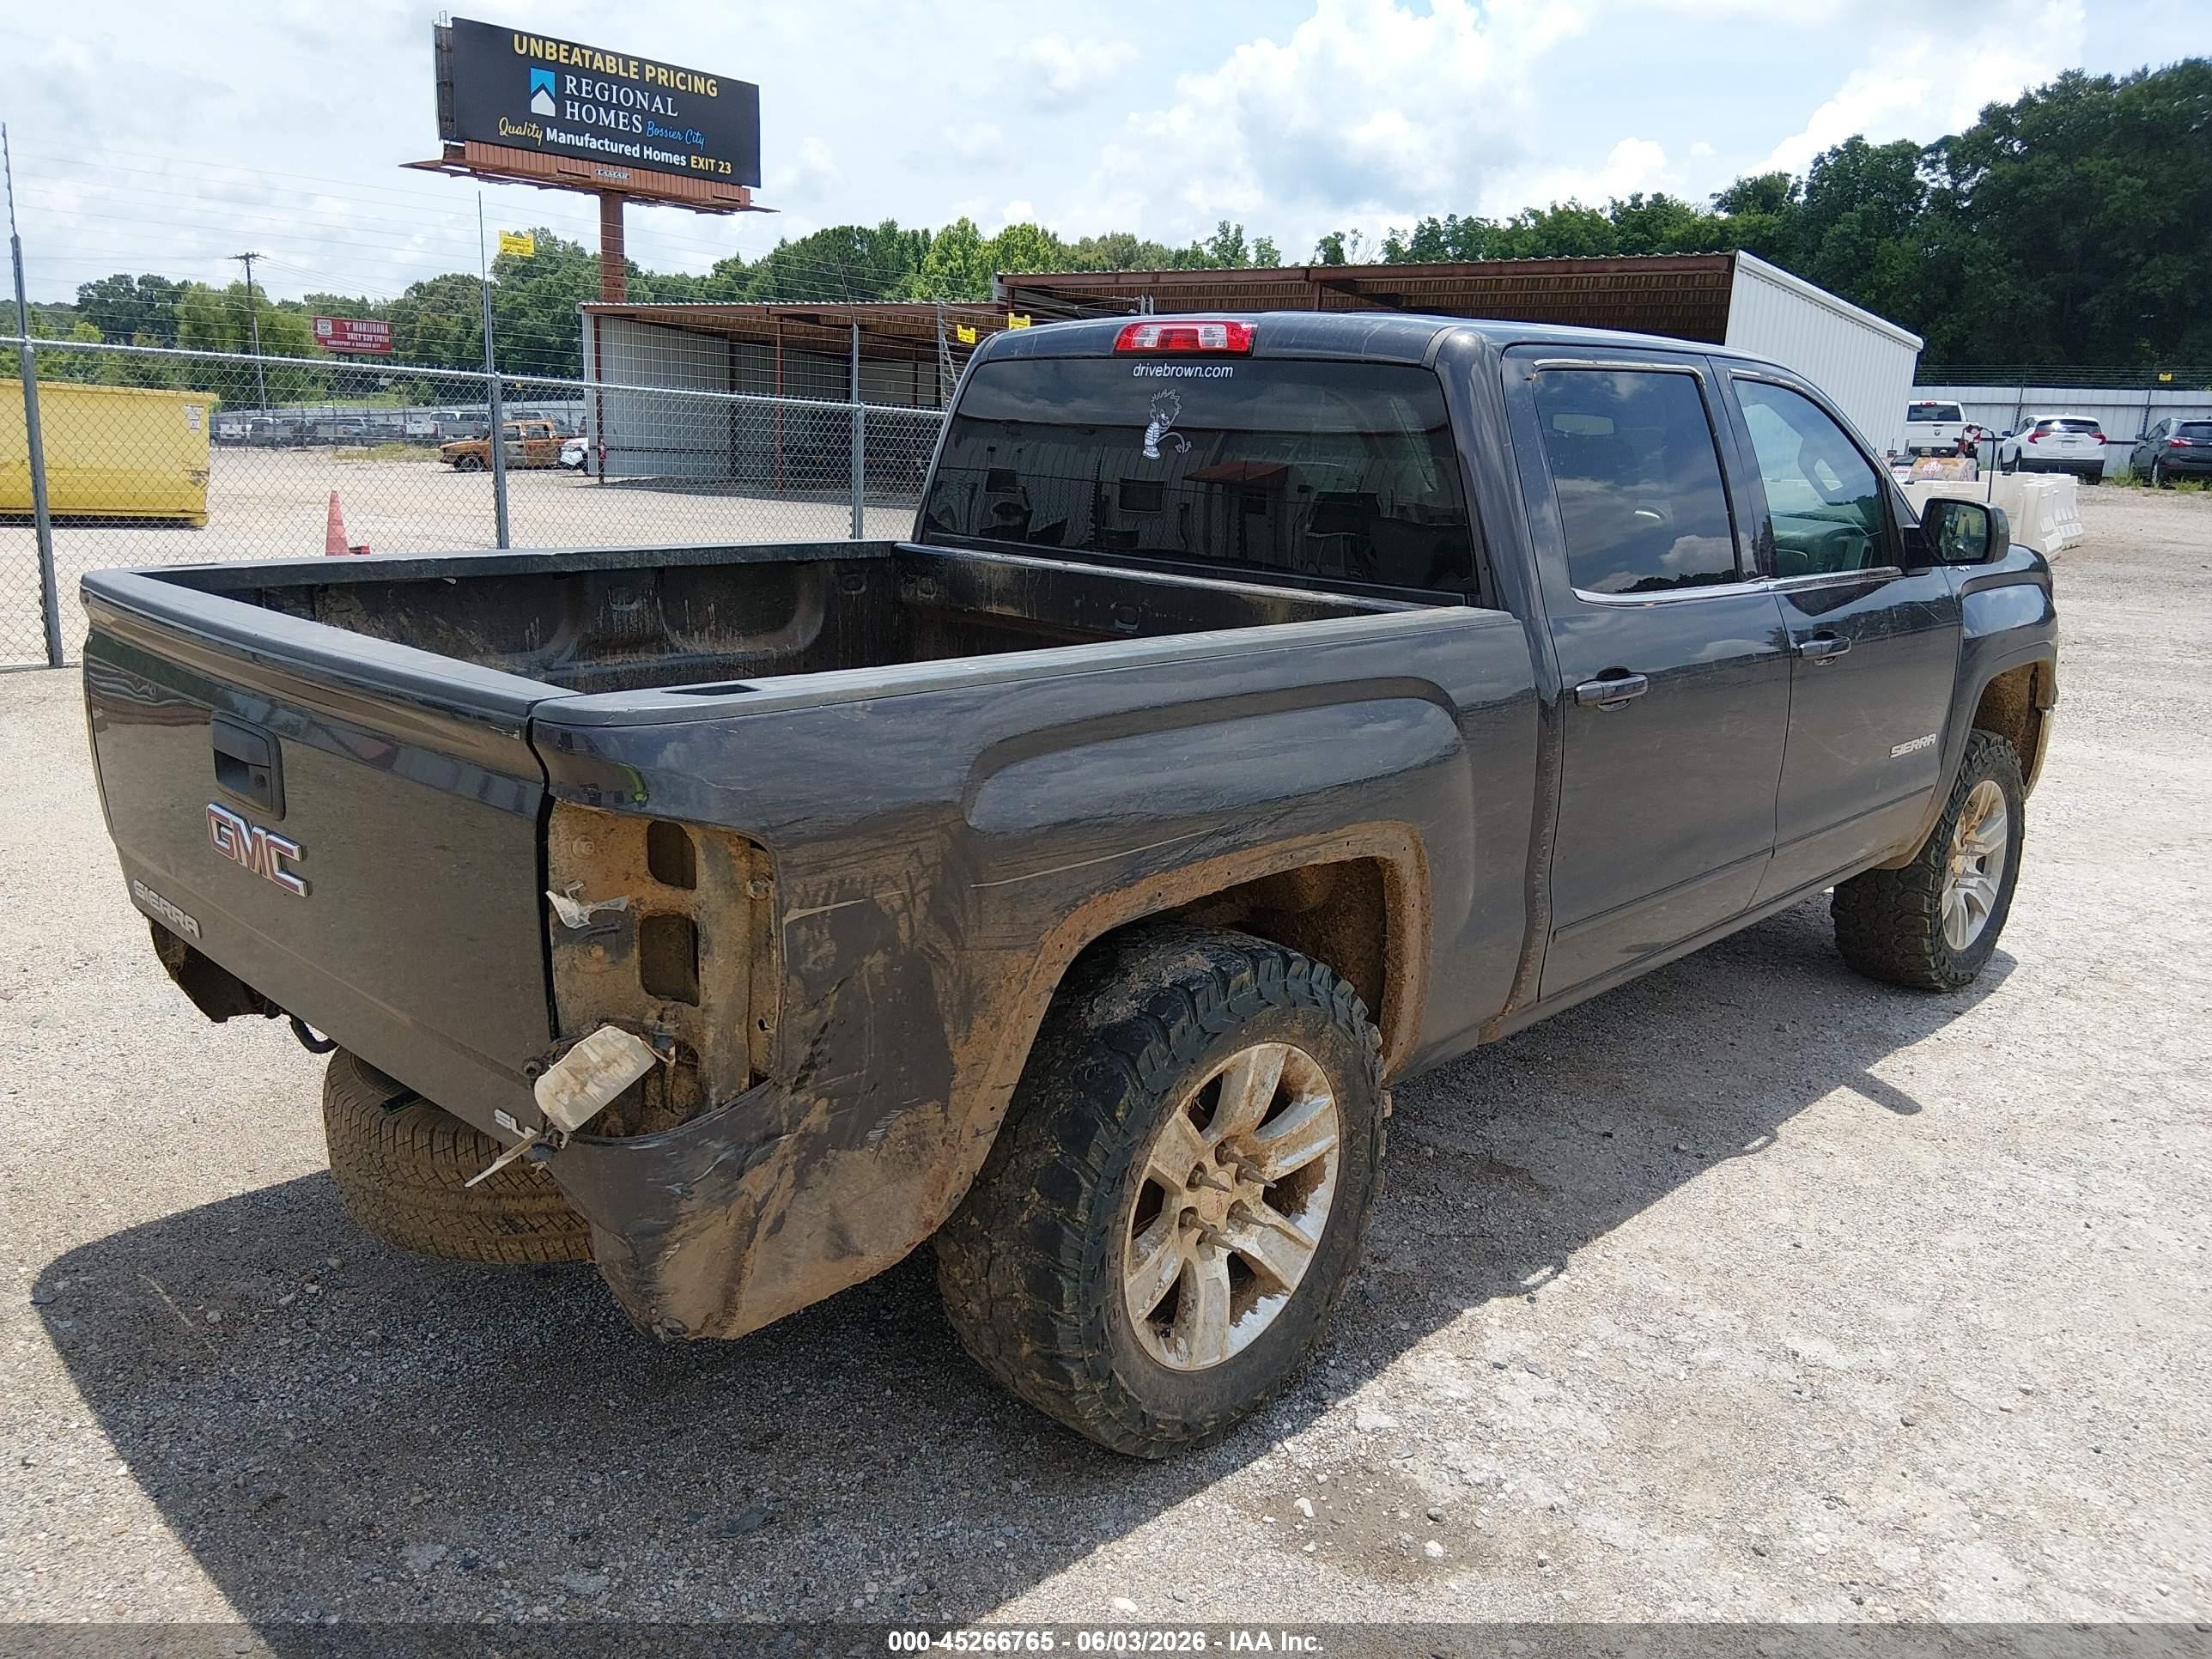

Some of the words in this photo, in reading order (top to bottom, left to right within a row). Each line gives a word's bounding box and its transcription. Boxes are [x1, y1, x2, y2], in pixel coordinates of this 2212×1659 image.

[514, 33, 640, 80] UNBEATABLE
[645, 64, 718, 97] PRICING
[564, 75, 678, 117] REGIONAL
[499, 117, 543, 147] Quality
[546, 126, 641, 158] Manufactured
[643, 145, 687, 167] Homes
[690, 155, 715, 172] EXIT
[718, 161, 732, 174] 23
[564, 100, 643, 134] HOMES
[647, 120, 684, 141] Bossier
[685, 128, 705, 152] City
[352, 321, 389, 335] MARIJUANA
[1133, 362, 1234, 378] drivebrown.com
[1889, 733, 1936, 758] SIERRA
[206, 803, 309, 897] GMC
[133, 878, 203, 940] SIERRA
